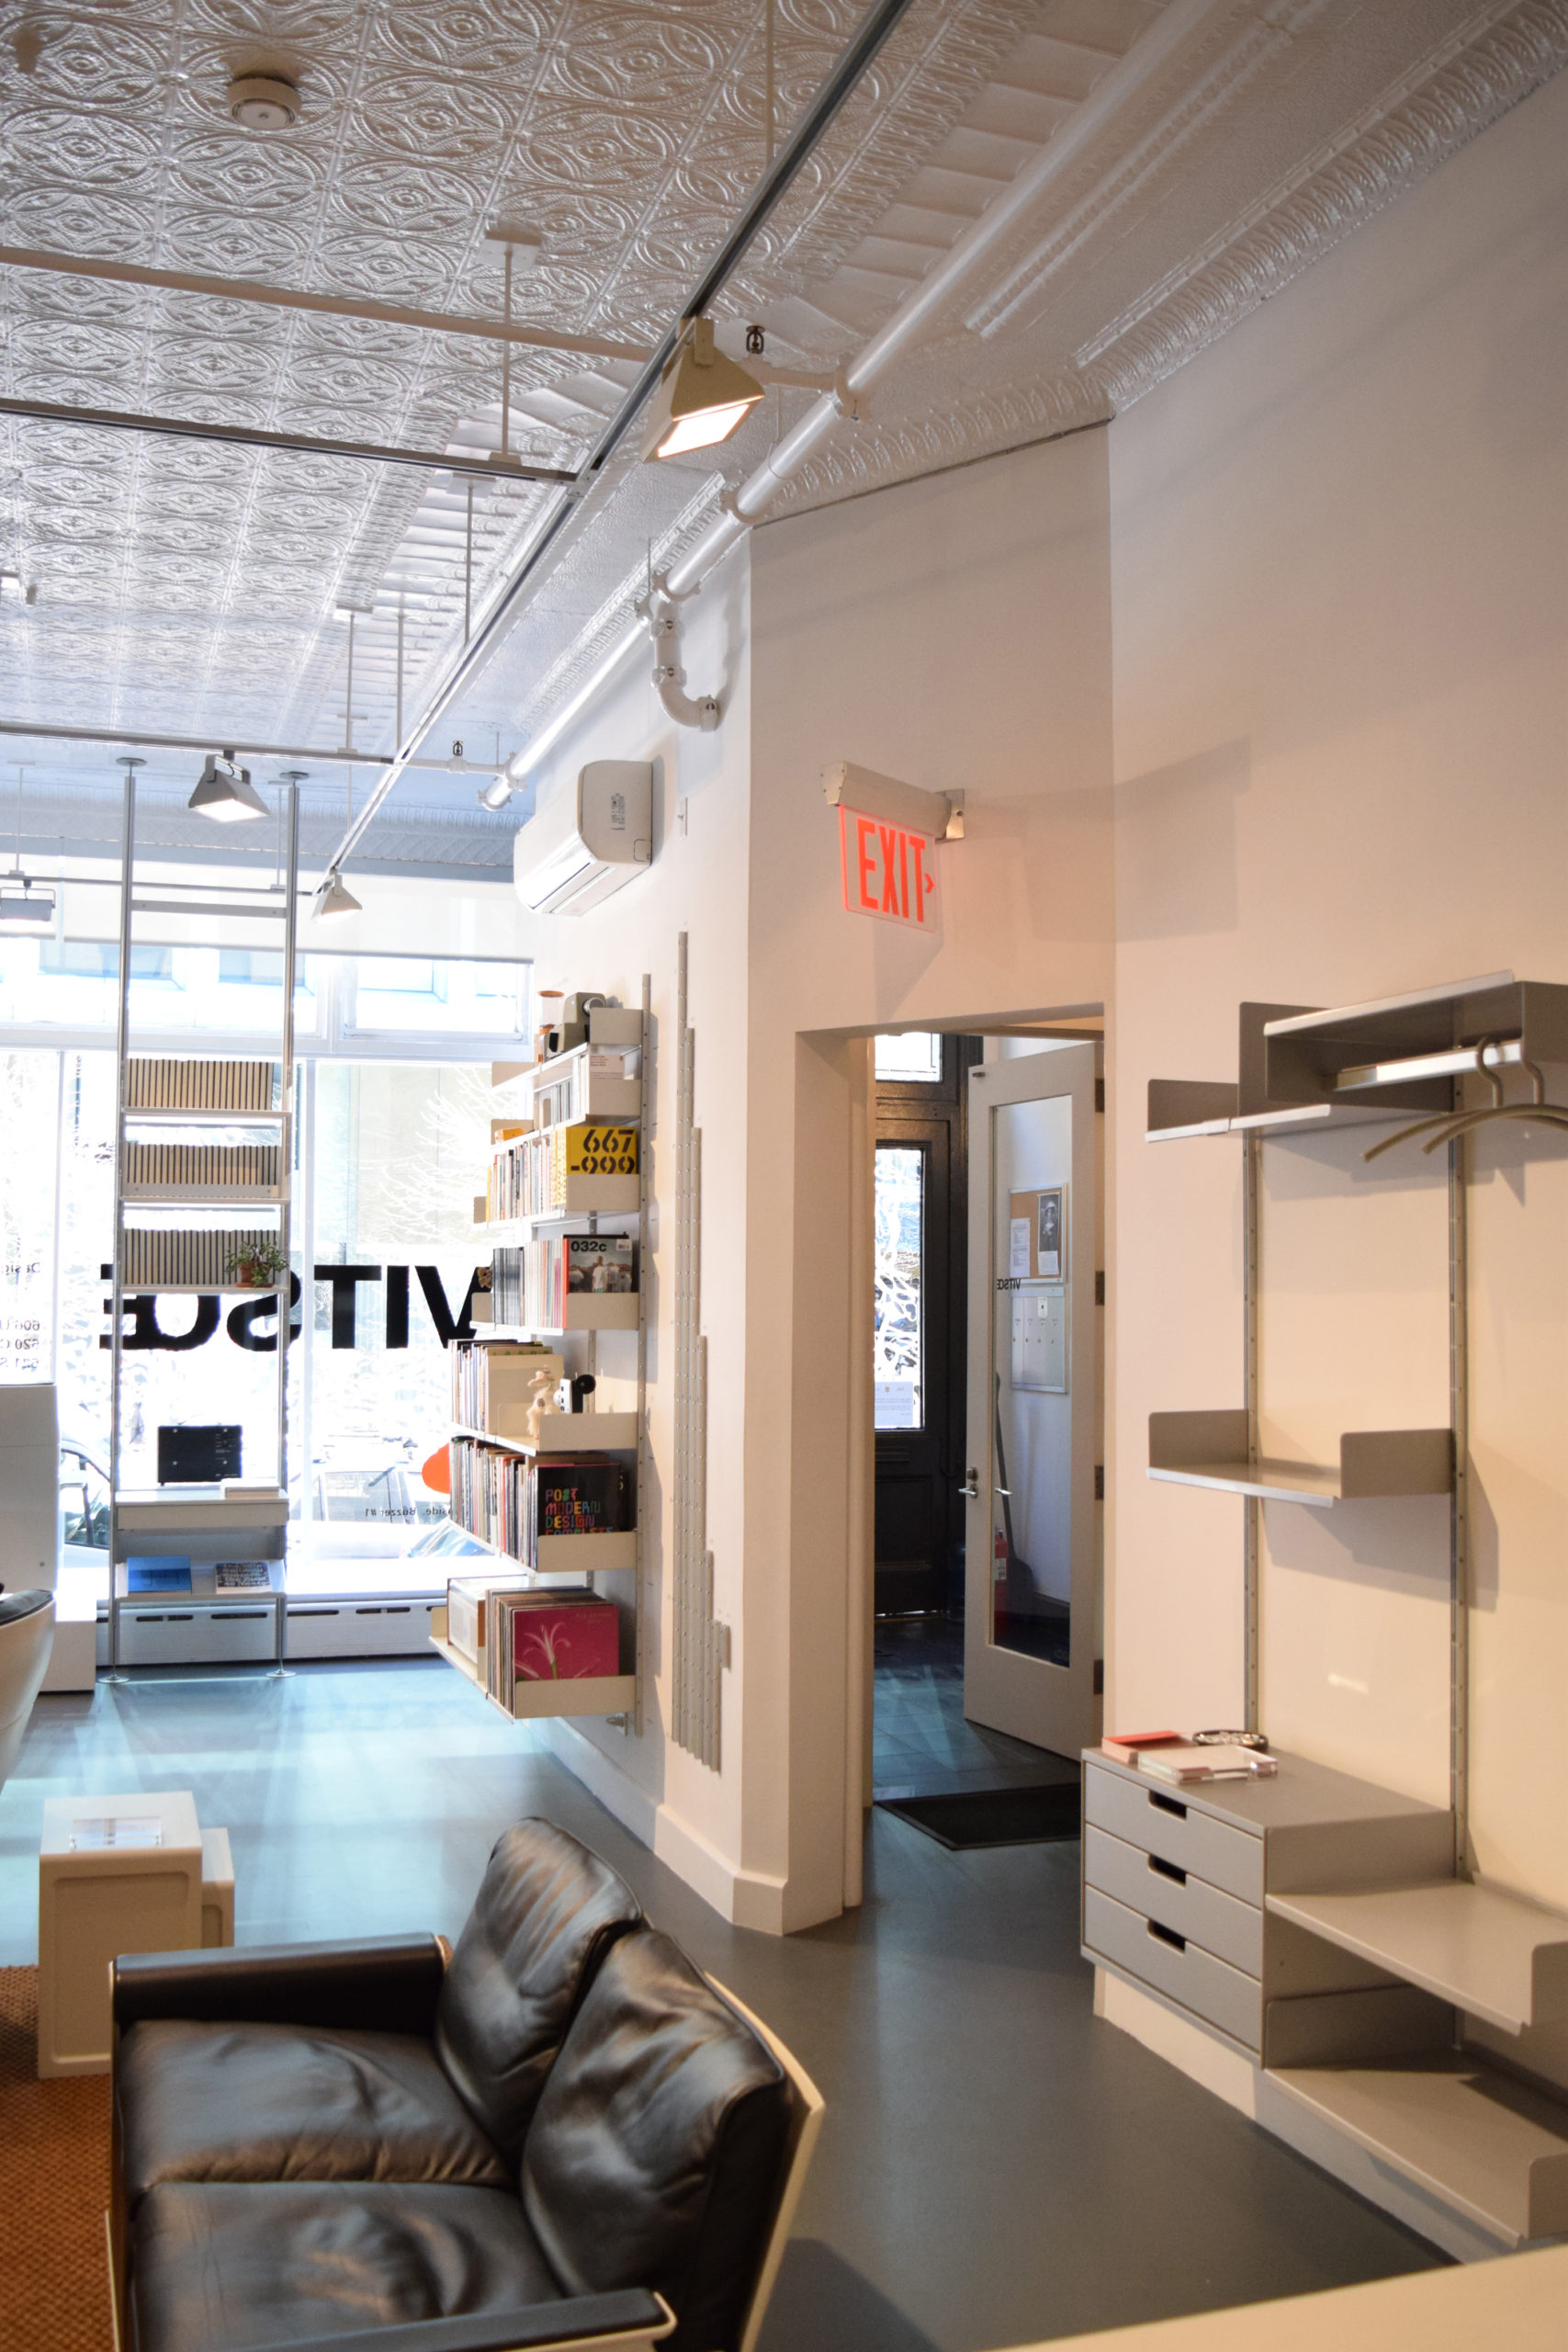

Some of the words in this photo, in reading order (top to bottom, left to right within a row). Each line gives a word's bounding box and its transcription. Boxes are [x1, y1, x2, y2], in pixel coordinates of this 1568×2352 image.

[856, 818, 926, 922] EXIT
[583, 1129, 634, 1153] 667
[570, 1240, 607, 1252] 032c
[546, 1488, 579, 1502] POST
[545, 1501, 601, 1515] MODERN
[545, 1514, 595, 1529] DESIGN
